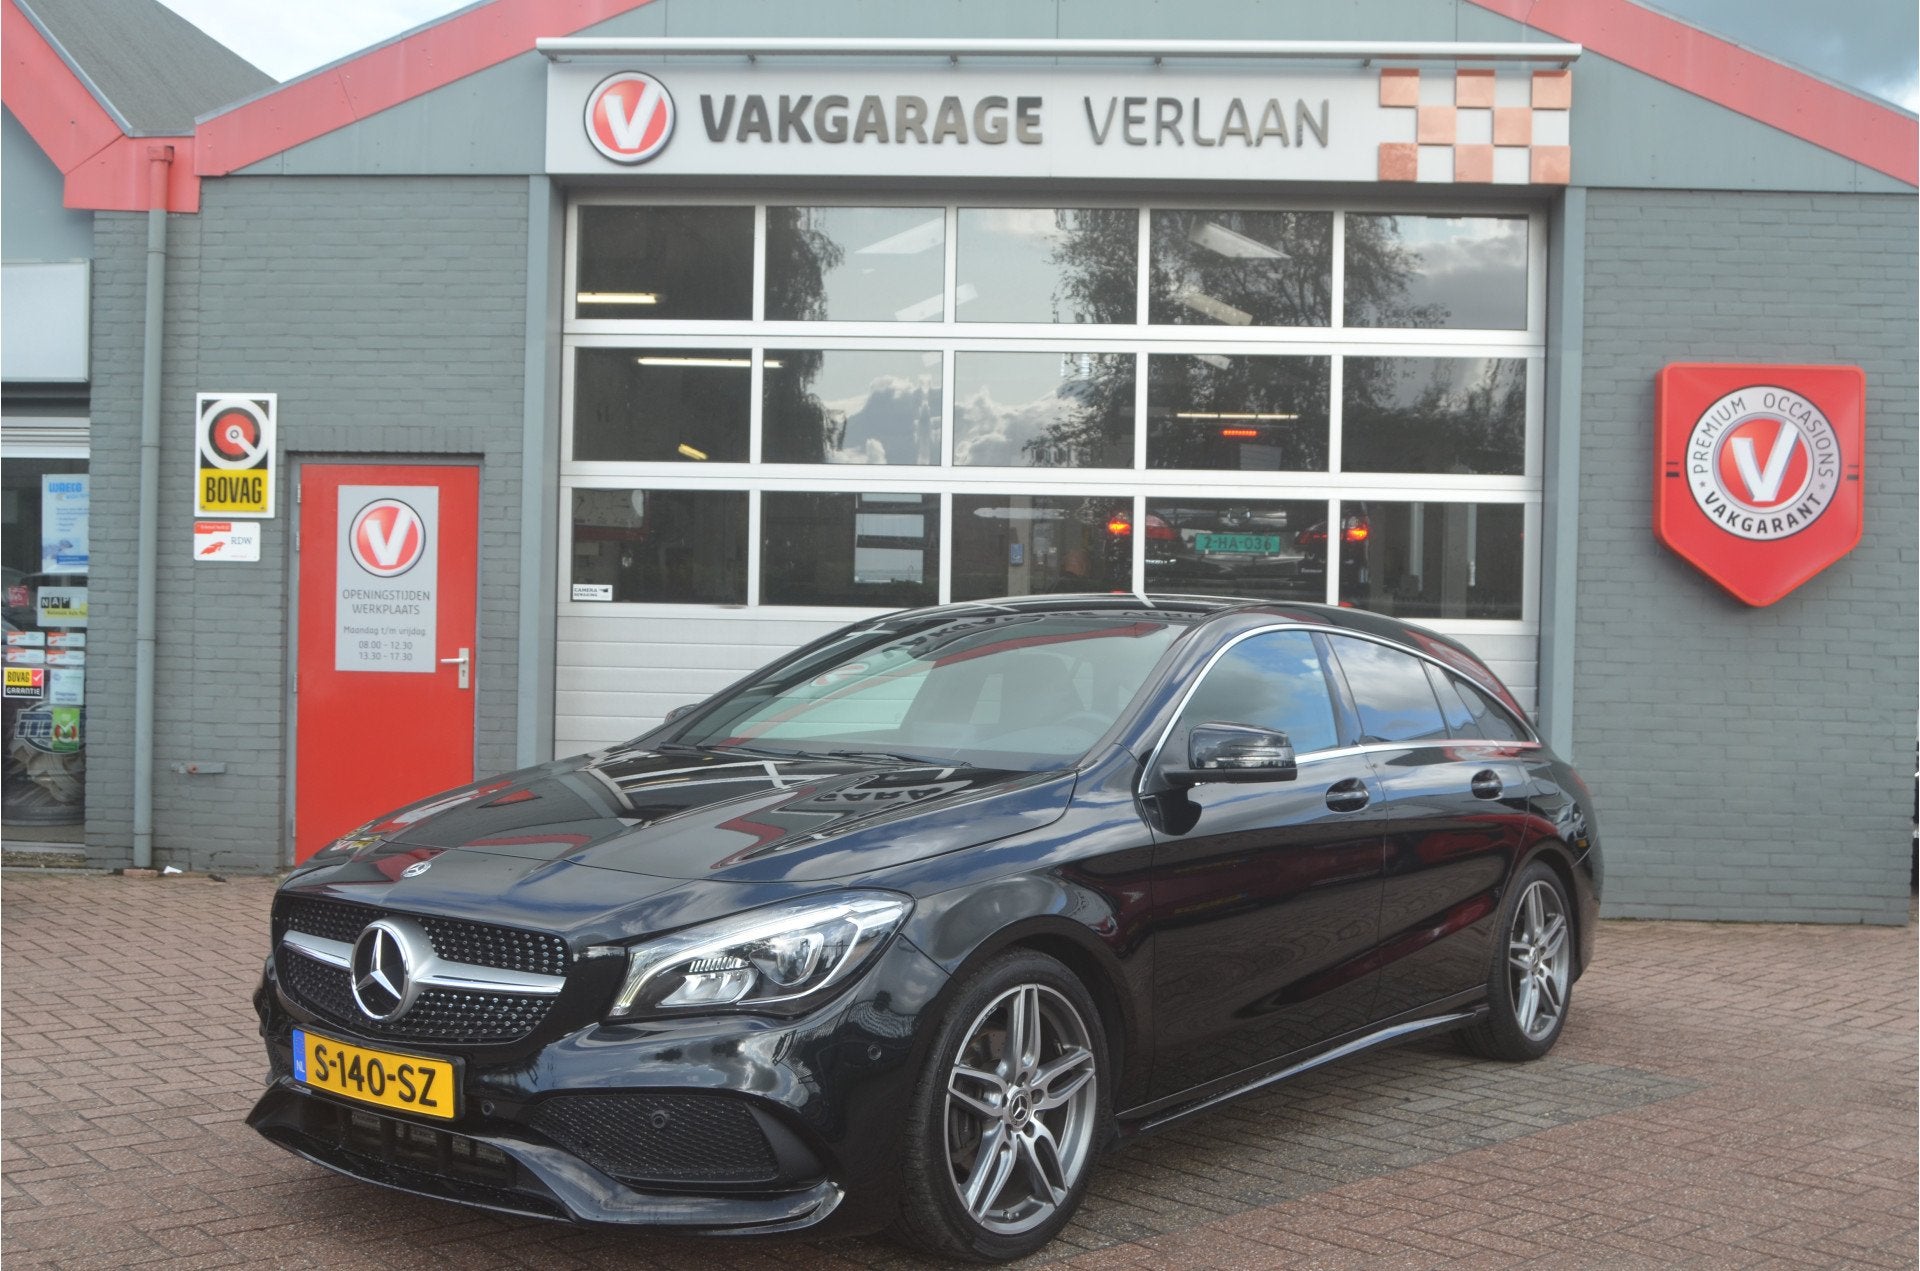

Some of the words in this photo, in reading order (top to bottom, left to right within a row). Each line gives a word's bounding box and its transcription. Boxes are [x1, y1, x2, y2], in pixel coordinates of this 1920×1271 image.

[699, 94, 1043, 144] VAKGARAGE
[1083, 96, 1329, 148] VERLAAN
[1692, 396, 1747, 475] PREMIUM
[1763, 392, 1834, 479] OCCASIONS
[205, 476, 263, 504] BOVAG
[1704, 491, 1821, 534] VAKGARANT
[230, 536, 253, 545] RDW
[1204, 536, 1272, 550] 2-HA-036
[342, 589, 431, 601] OPENINGSTIJDEN
[351, 603, 421, 615] WERKPLAATS
[343, 626, 379, 635] Maandag
[380, 626, 397, 635] t/m
[358, 640, 381, 649] 08.00
[390, 641, 413, 650] 12.30
[359, 651, 381, 660] 13.30
[7, 671, 31, 683] BOVAG
[6, 687, 41, 696] GARANTIE
[314, 1043, 438, 1108] S-140-SZ
